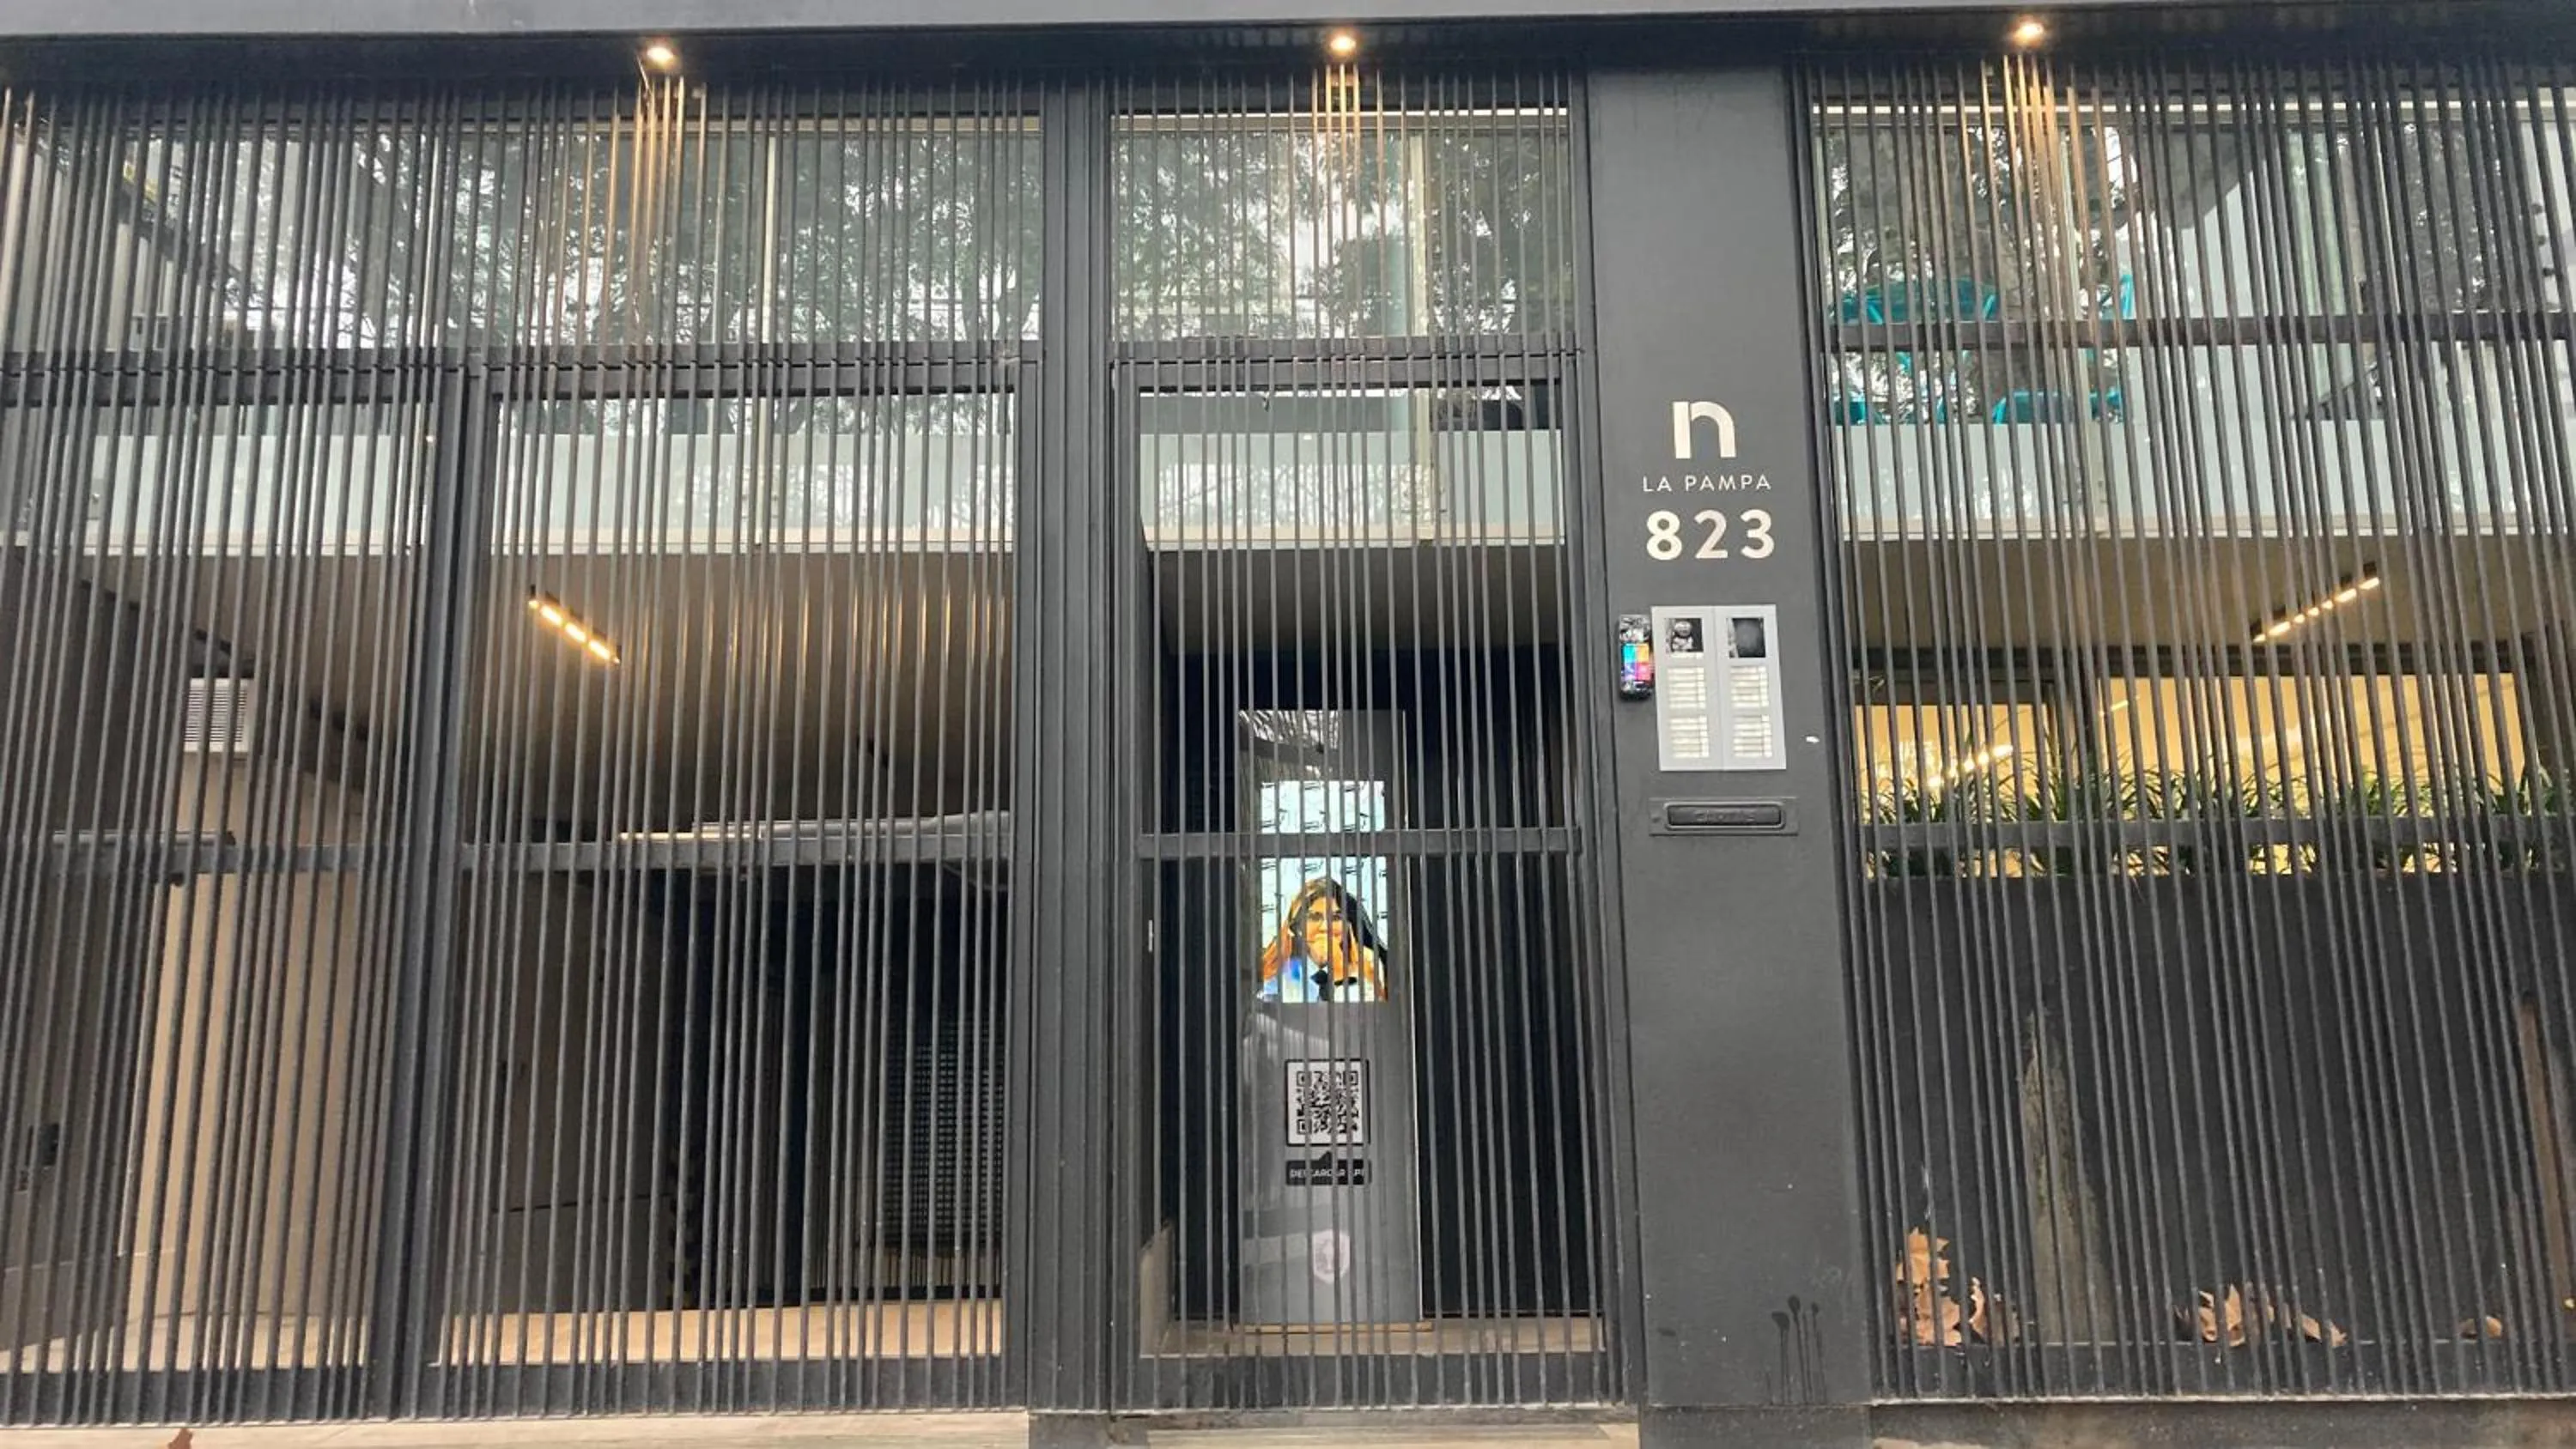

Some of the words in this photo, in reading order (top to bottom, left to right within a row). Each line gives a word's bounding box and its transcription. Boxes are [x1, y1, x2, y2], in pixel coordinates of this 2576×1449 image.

[1672, 400, 1737, 460] n
[1642, 475, 1674, 493] LA
[1684, 472, 1772, 493] PAMPA
[1645, 508, 1775, 561] 823
